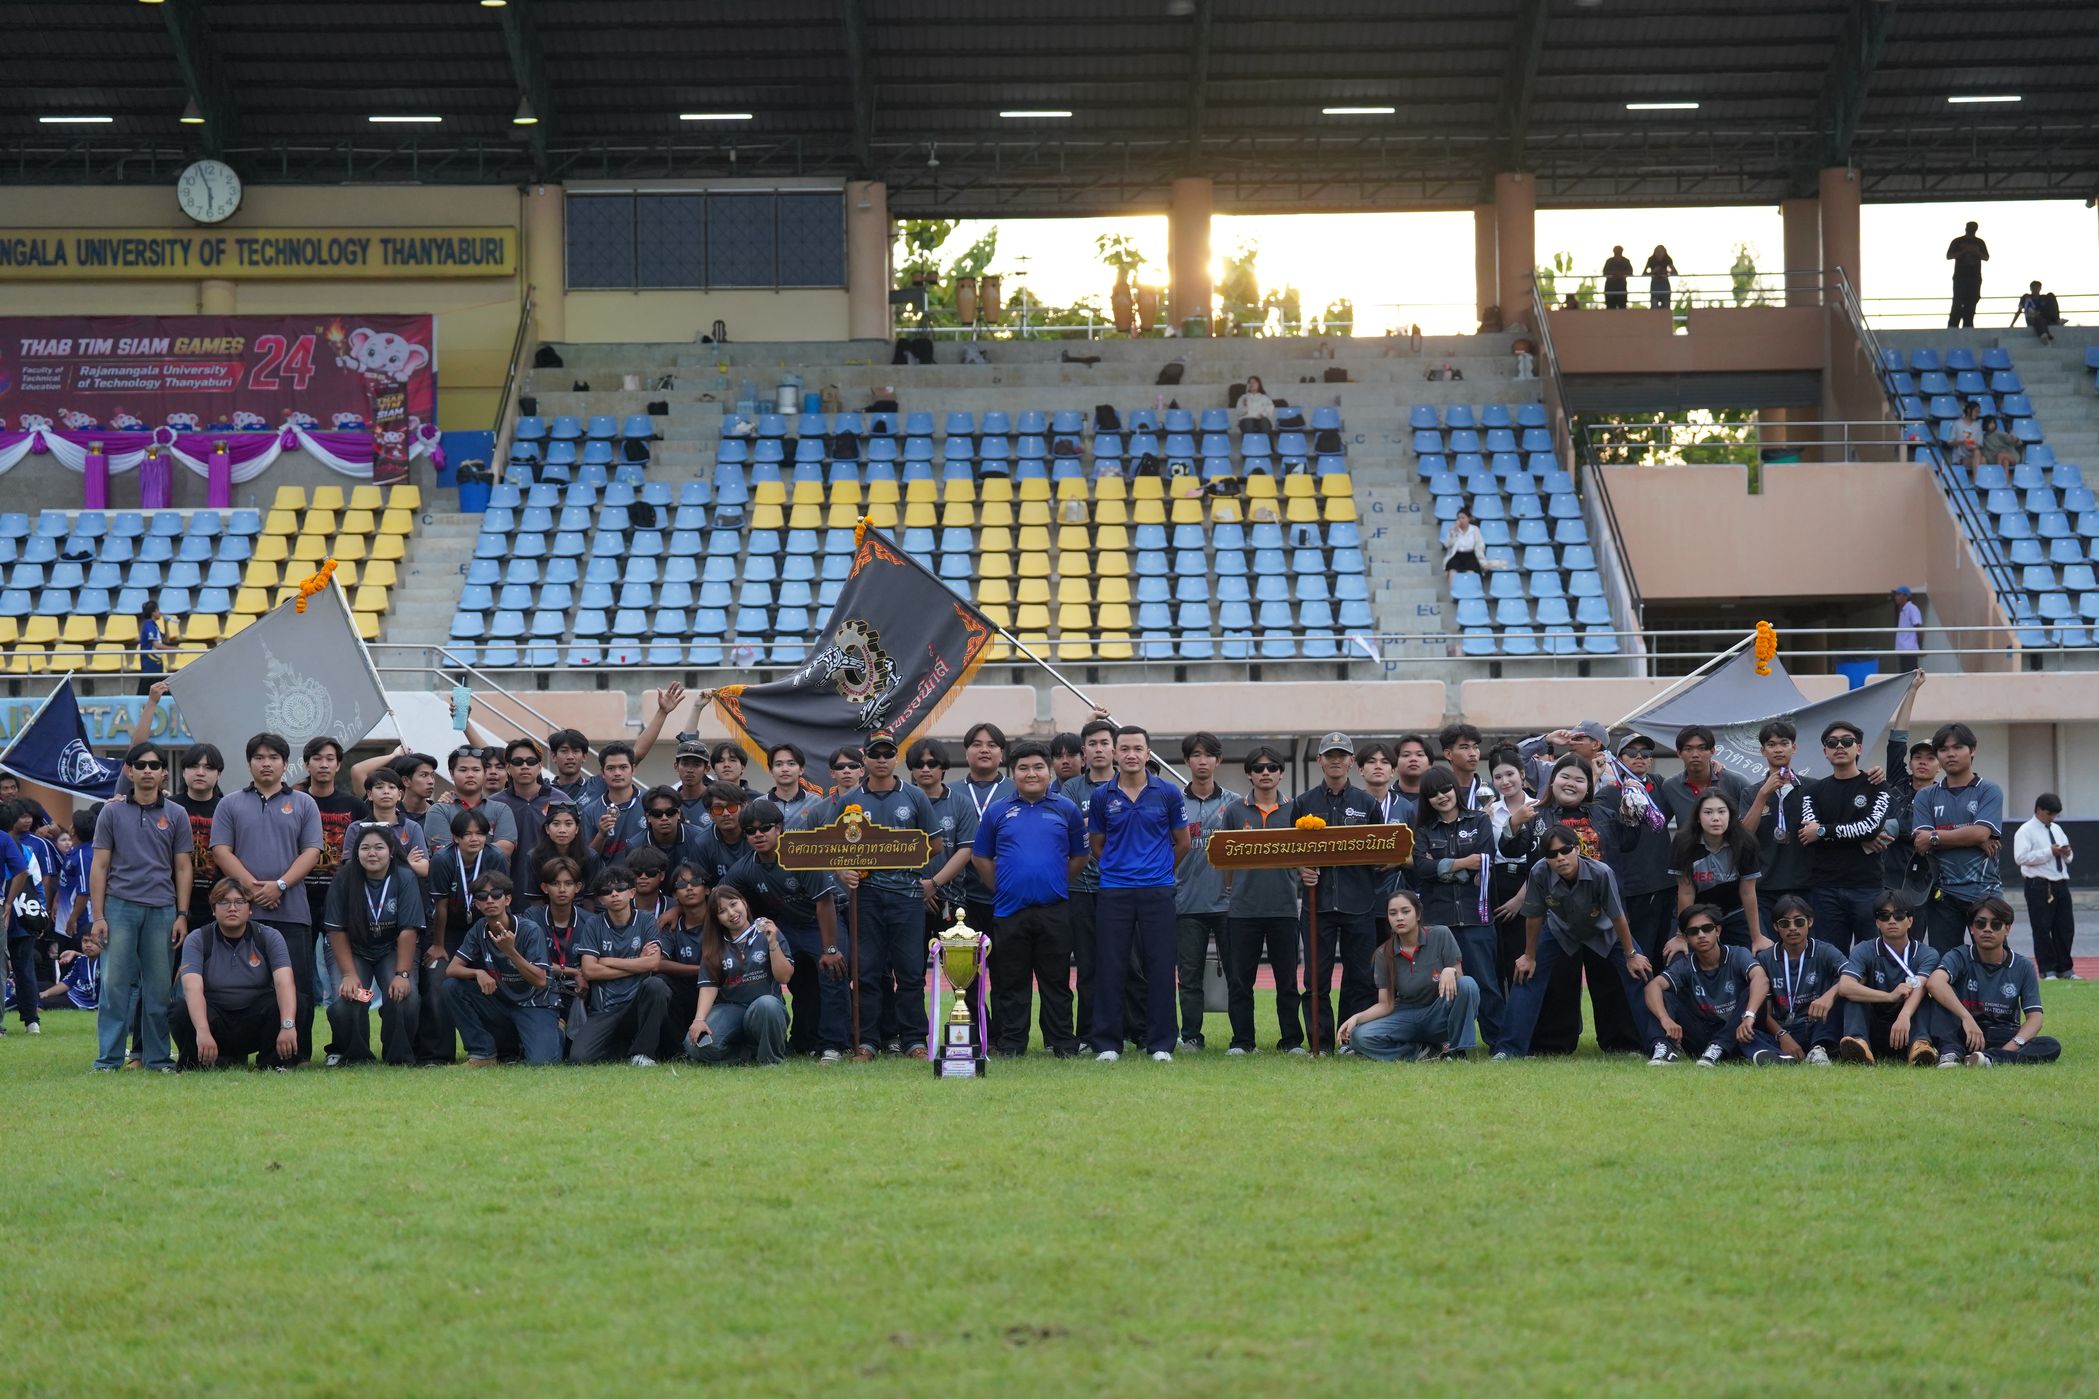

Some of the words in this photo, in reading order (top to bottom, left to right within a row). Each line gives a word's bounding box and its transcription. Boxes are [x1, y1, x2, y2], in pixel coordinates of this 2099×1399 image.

[204, 165, 215, 176] 12
[75, 238, 193, 267] UNIVERSITY
[198, 238, 227, 266] OF
[234, 238, 371, 266] TECHNOLOGY
[380, 237, 504, 265] THANYABURI
[20, 339, 73, 357] THAB
[78, 338, 114, 356] TIM
[117, 337, 171, 355] SIAM
[174, 336, 246, 355] GAMES
[248, 334, 317, 390] 24
[22, 366, 52, 375] Faculty
[55, 366, 64, 374] of
[80, 365, 160, 378] Rajamangala
[163, 364, 228, 376] University
[21, 383, 62, 391] Education
[78, 379, 91, 389] of
[93, 378, 162, 390] Technology
[165, 376, 233, 389] Thanyaburi
[787, 838, 920, 855] วิศวกรรมเมคคาทรอนิกส์
[1225, 830, 1399, 857] วิศวกรรมเมคคาทรอนิกส์
[721, 958, 733, 970] 39
[1773, 977, 1784, 989] 15
